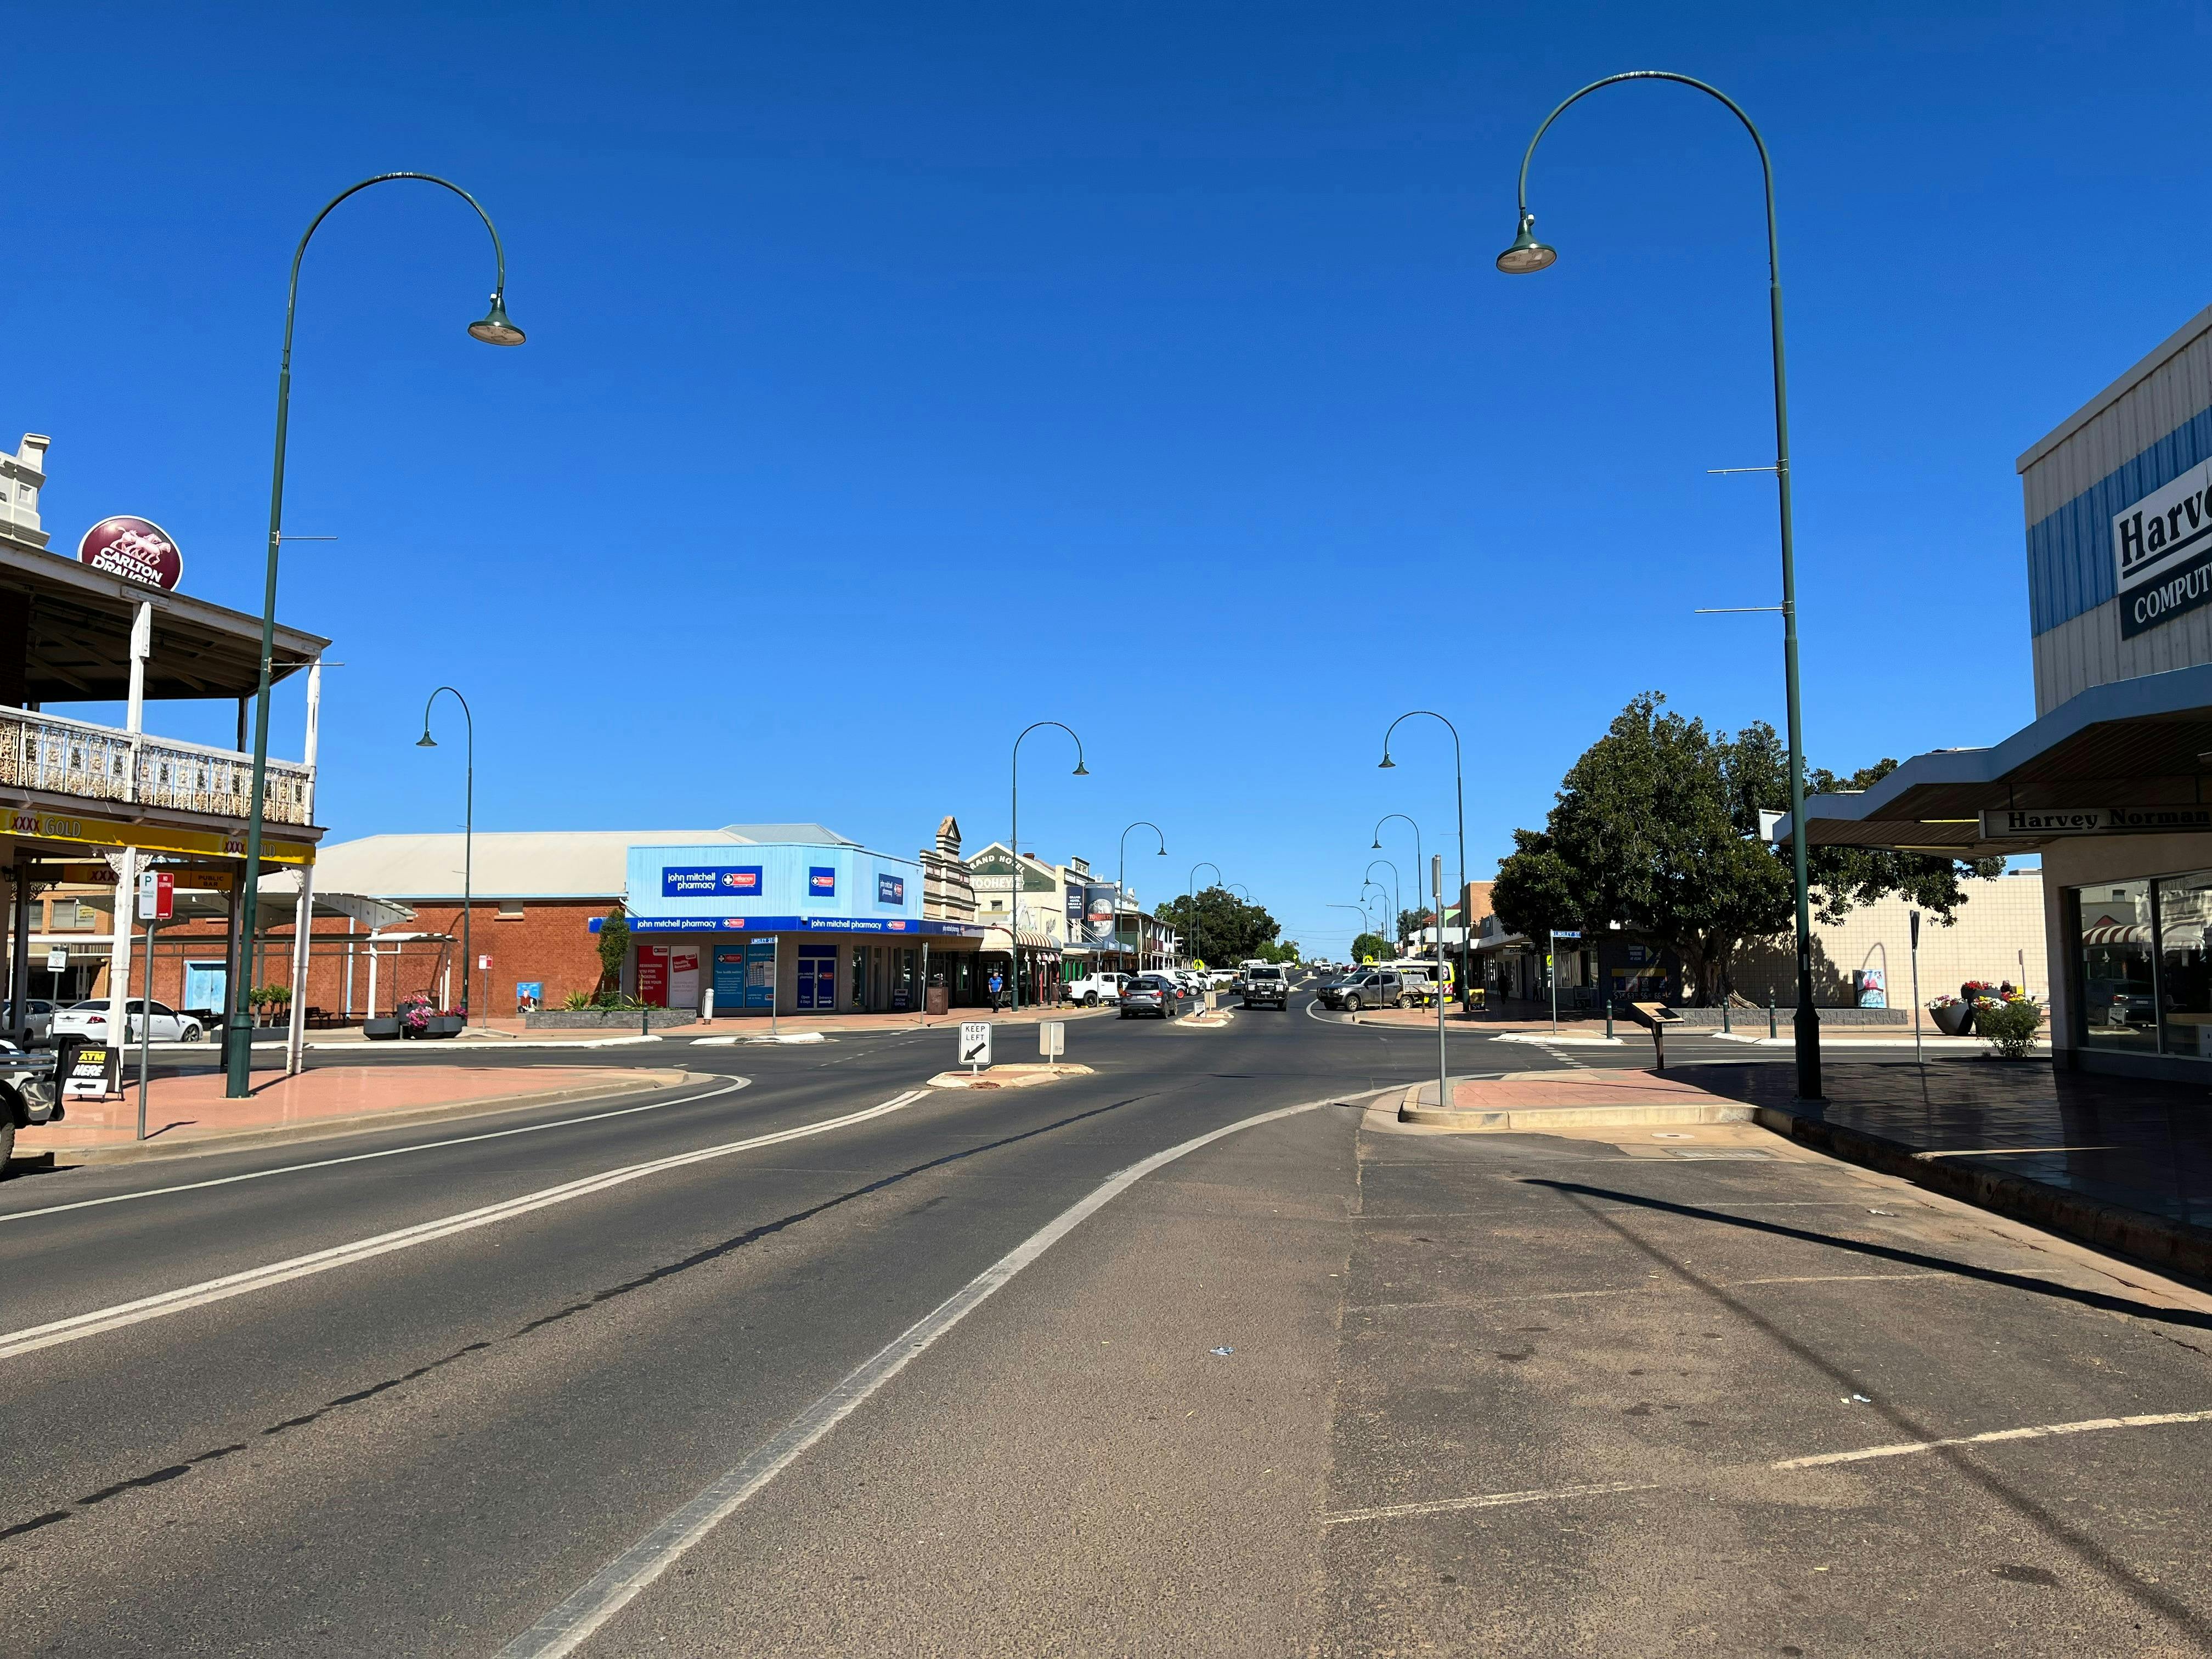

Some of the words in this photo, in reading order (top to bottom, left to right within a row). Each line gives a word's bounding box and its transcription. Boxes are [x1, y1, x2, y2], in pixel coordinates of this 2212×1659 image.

[91, 555, 161, 588] DRAU
[100, 547, 163, 583] CARLTON
[2134, 562, 2212, 624] COMPUT
[2007, 811, 2098, 830] Harvey
[2108, 808, 2211, 826] Norman
[11, 816, 40, 832] XXXX
[45, 817, 81, 837] GOLD
[224, 841, 245, 854] XXXX
[258, 843, 276, 857] OLD
[970, 855, 995, 870] RAND
[145, 876, 152, 887] P
[668, 872, 685, 883] john
[686, 872, 715, 881] mitchell
[678, 881, 715, 891] pharmacy
[637, 919, 652, 929] john
[654, 919, 680, 927] mitchell
[681, 919, 716, 929] pharmacy
[811, 919, 826, 928] john
[851, 921, 882, 929] pharmacy
[78, 1053, 105, 1061] ATM
[72, 1064, 104, 1077] HERE
